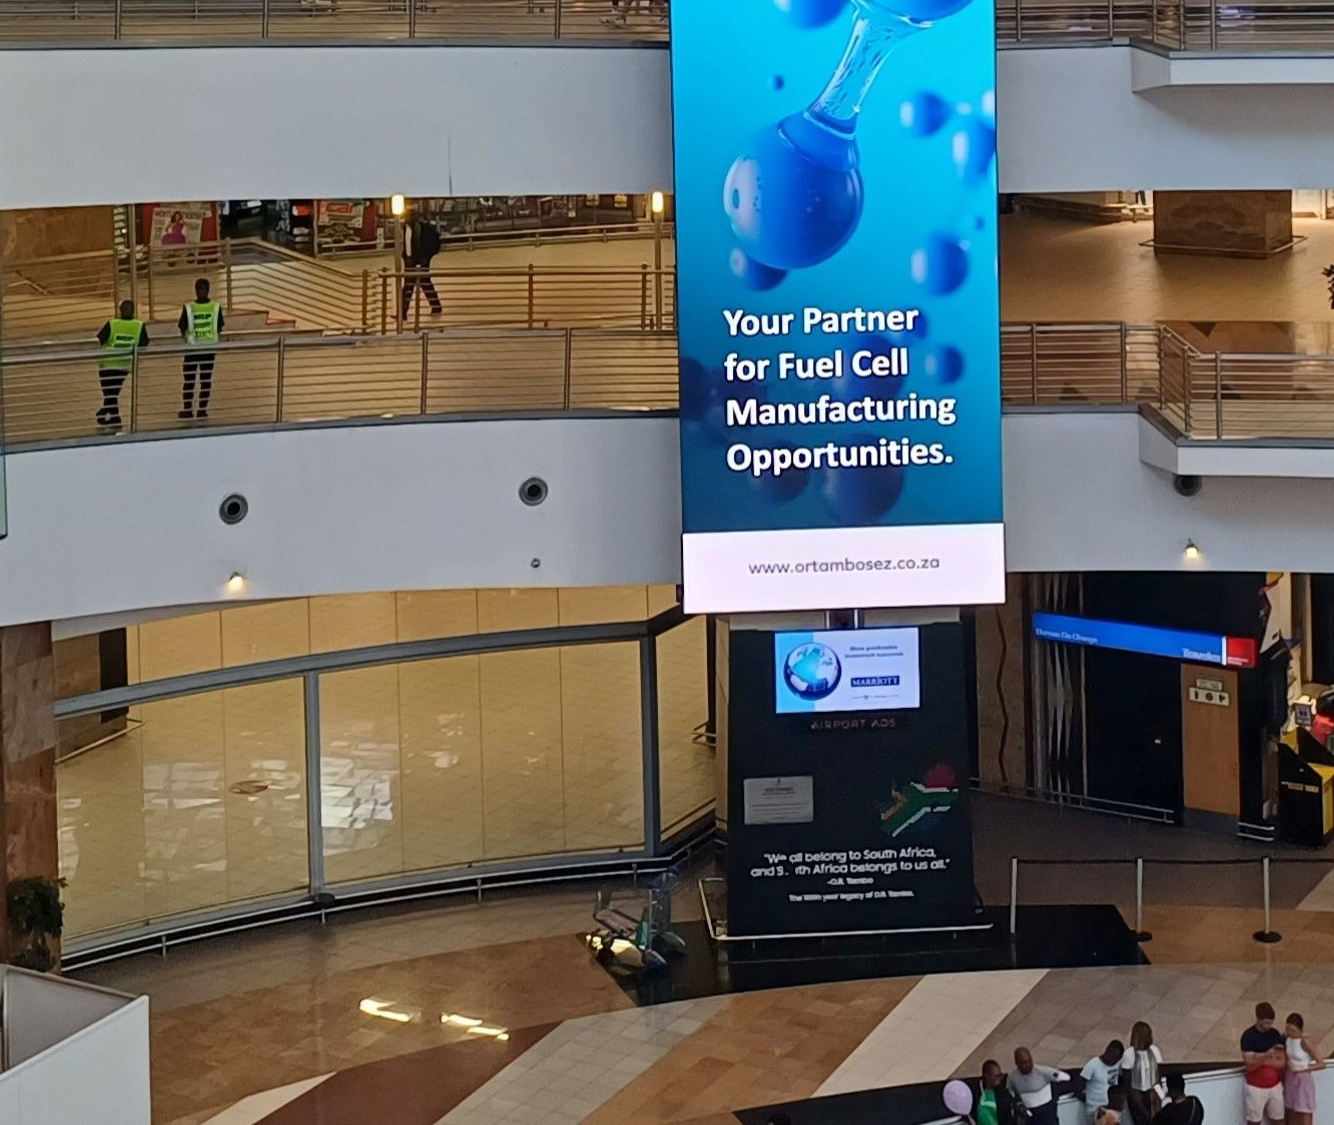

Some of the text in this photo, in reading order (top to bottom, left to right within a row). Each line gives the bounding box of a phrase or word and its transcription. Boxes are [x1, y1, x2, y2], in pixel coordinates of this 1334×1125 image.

[723, 307, 919, 336] Your Partner
[724, 347, 908, 381] for Fuel Cell
[726, 393, 956, 426] Manufacturing
[726, 437, 954, 477] Opportunities.
[748, 557, 940, 574] www.ortambosez.co.za
[852, 677, 898, 686] MARRIOTT
[811, 718, 896, 729] AIRPORT ADS
[805, 851, 847, 863] belong
[849, 850, 861, 860] to
[864, 849, 897, 859] South
[751, 866, 775, 876] and
[813, 863, 848, 874] Africa
[850, 861, 898, 874] belongs
[900, 860, 913, 870] to
[914, 861, 928, 870] us
